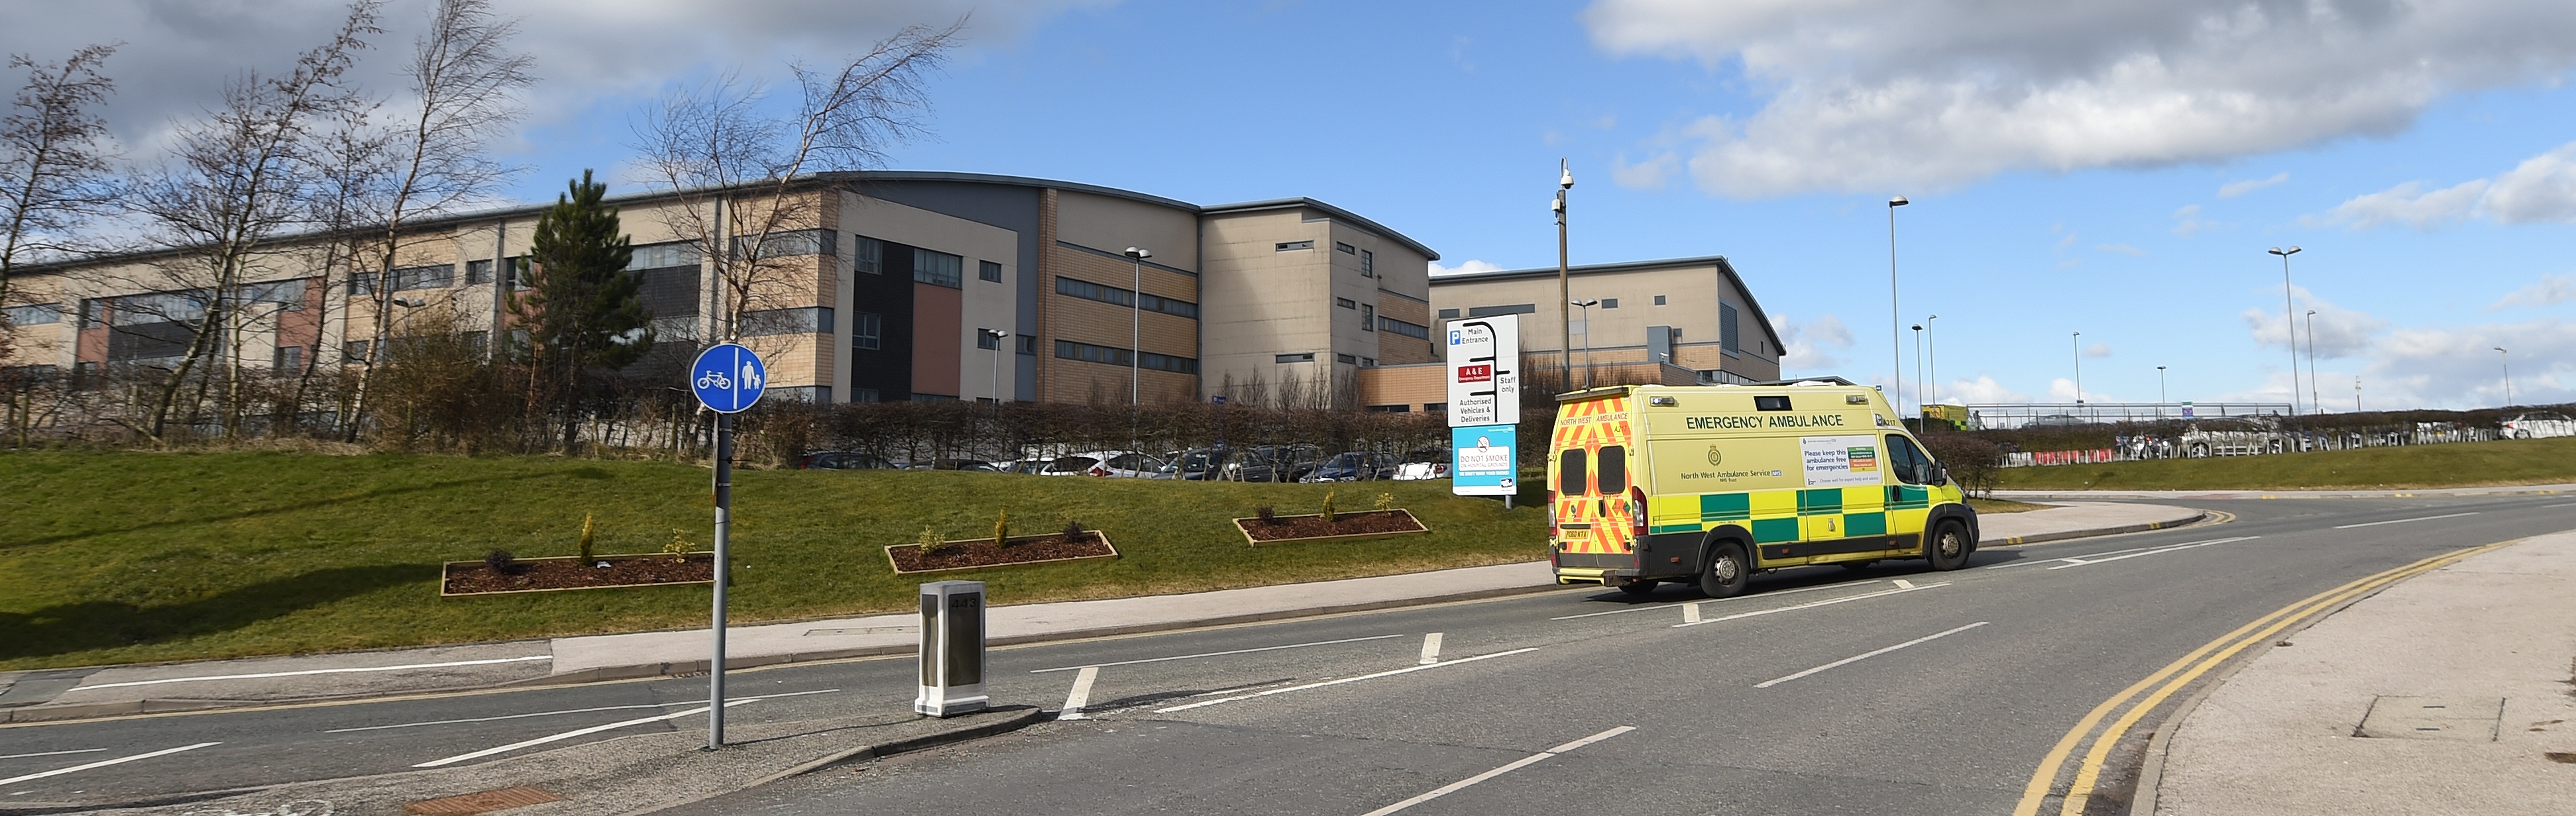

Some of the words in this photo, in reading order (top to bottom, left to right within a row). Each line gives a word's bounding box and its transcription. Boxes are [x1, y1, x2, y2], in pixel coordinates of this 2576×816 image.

[1596, 413, 1628, 422] AMBULANCE
[1686, 416, 1763, 429] EMERGENCY
[1769, 414, 1844, 427] AMBULANCE
[1816, 463, 1848, 471] emergencies
[952, 598, 976, 609] 443
